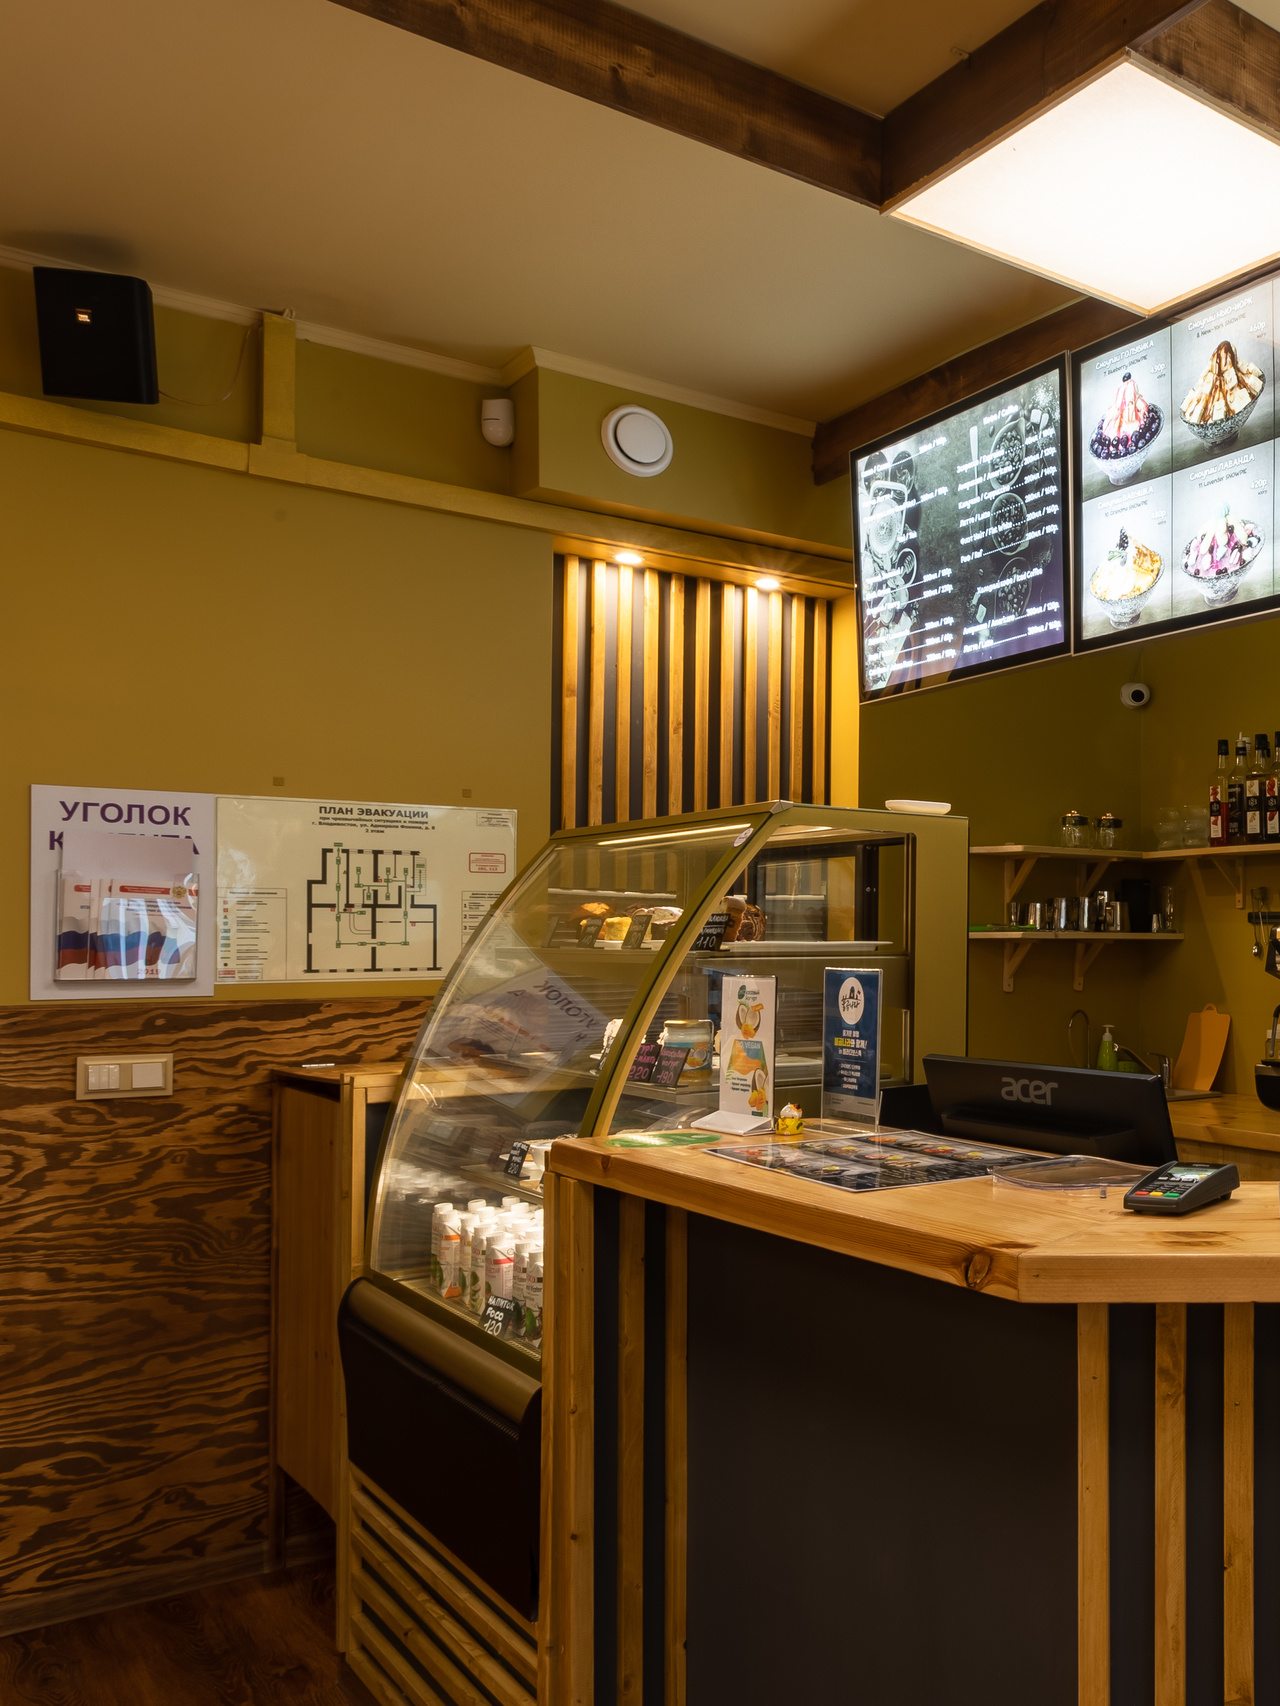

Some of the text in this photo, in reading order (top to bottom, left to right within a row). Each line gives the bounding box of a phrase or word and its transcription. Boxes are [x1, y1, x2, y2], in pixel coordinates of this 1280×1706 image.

[1188, 315, 1216, 330] Сноупай
[1121, 340, 1154, 359] ГОЛУБИКА
[1108, 365, 1128, 375] Blueberry
[1190, 453, 1255, 480] Сноупай ЛАВАНДА
[1203, 468, 1247, 486] Lavender SNOWPIE
[1122, 486, 1154, 501] БАБУШКА
[59, 801, 191, 826] УГОЛОК
[319, 806, 428, 819] ПЛАН ЭВАКУАЦИИ
[1001, 1077, 1058, 1105] acer
[488, 1296, 515, 1311] НАПИТОК
[484, 1320, 502, 1336] 120
